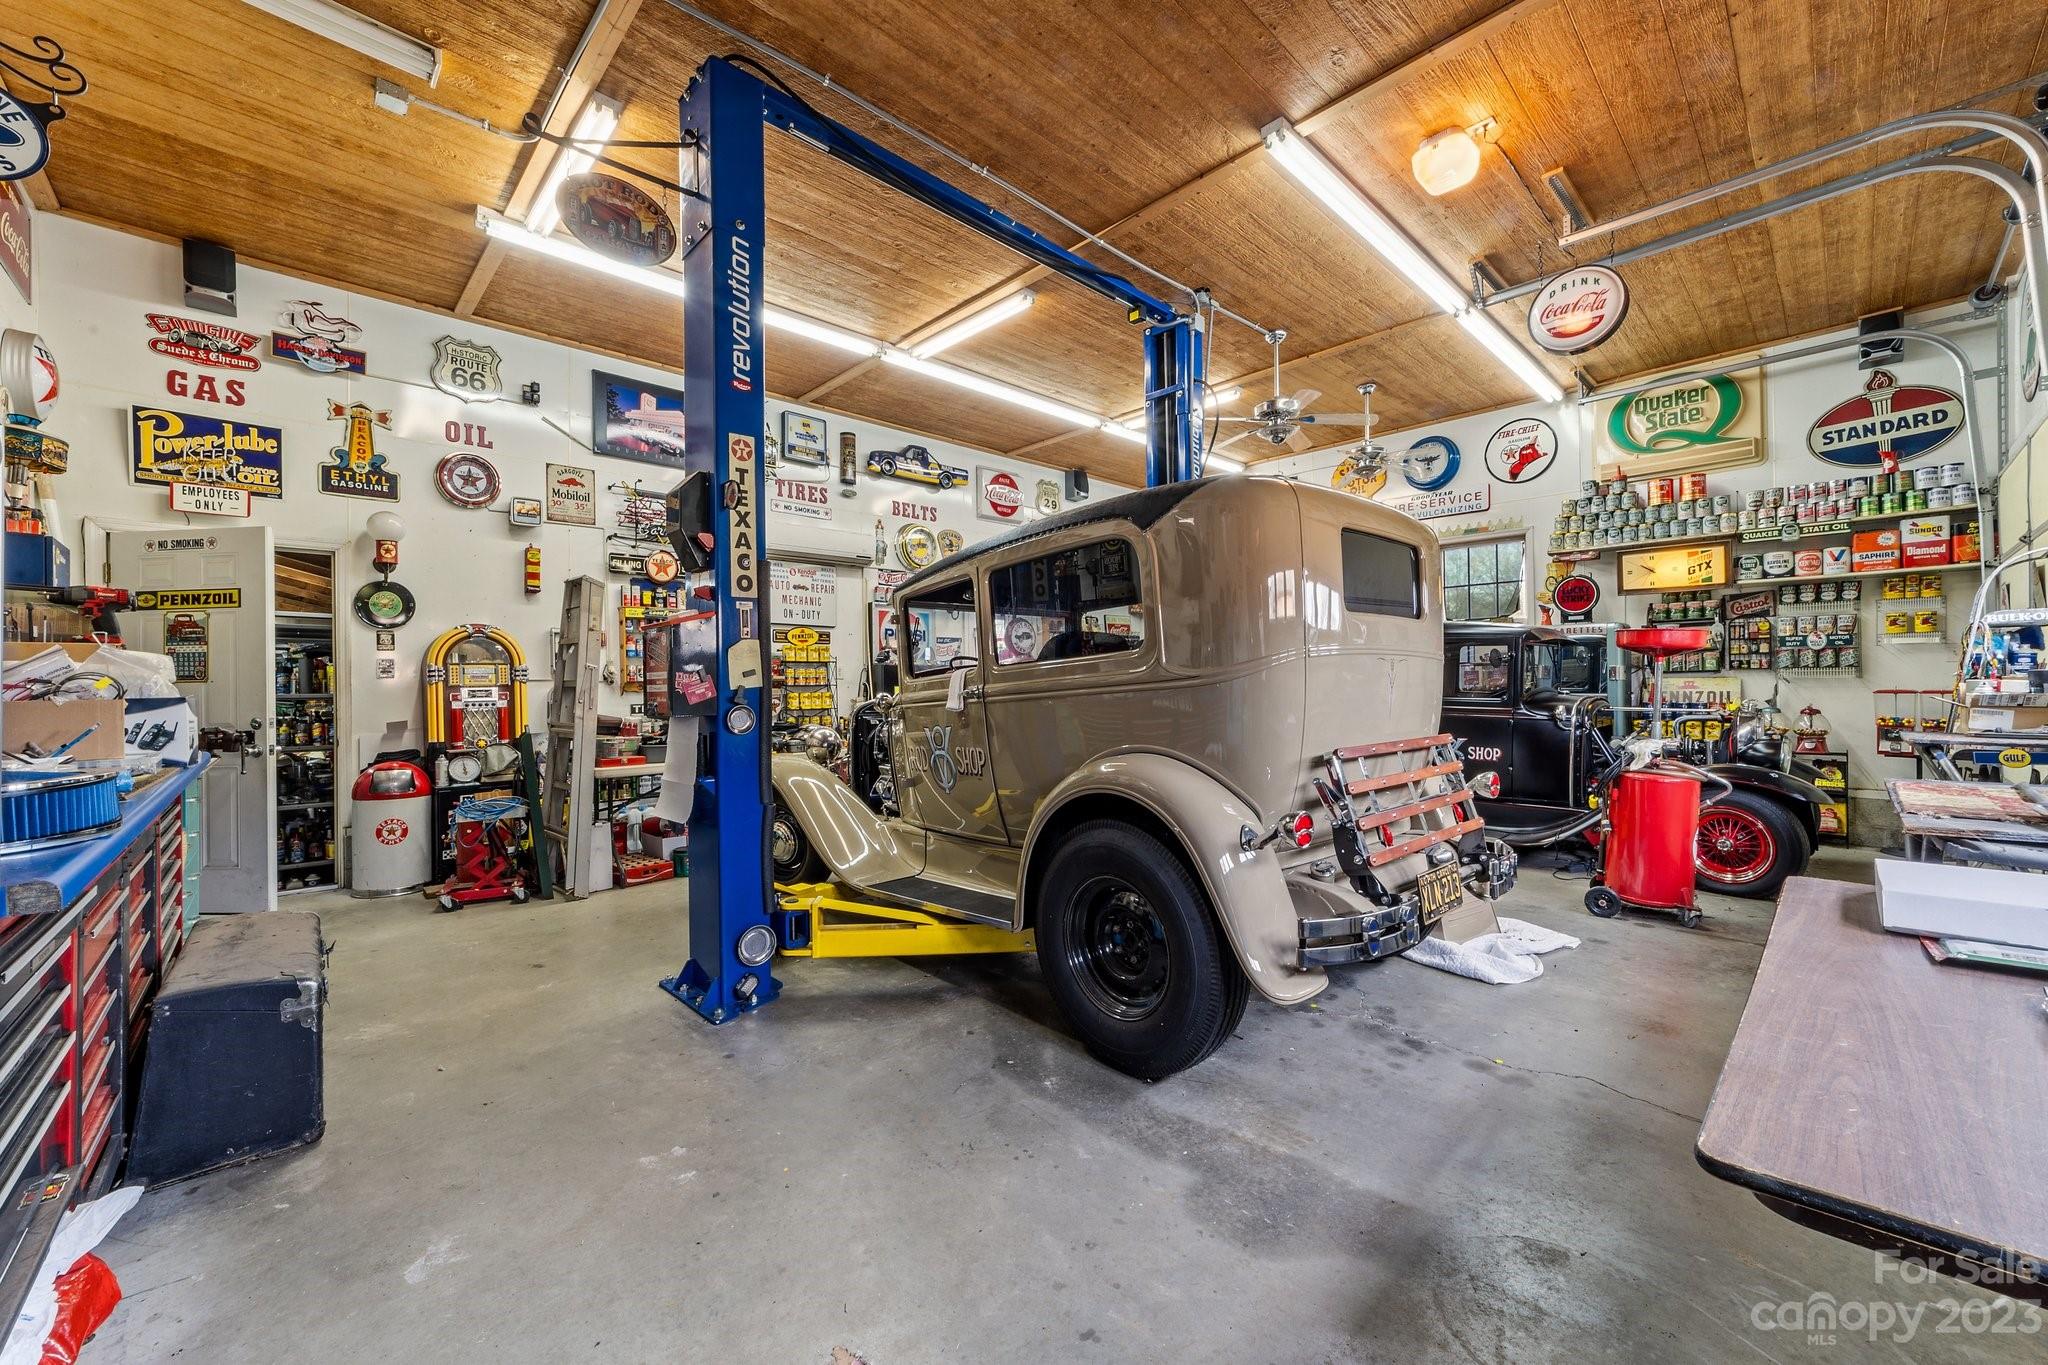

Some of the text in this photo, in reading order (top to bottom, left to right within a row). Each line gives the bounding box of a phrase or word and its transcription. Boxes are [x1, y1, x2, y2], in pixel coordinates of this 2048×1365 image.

[1549, 277, 1601, 299] DRINK
[728, 236, 751, 382] revolution
[1541, 288, 1611, 324] Coca-Cola
[156, 341, 196, 357] Suede
[198, 349, 207, 359] &
[209, 352, 256, 369] Chrome
[450, 357, 488, 373] ROUTE
[450, 367, 487, 392] 66
[166, 369, 246, 407] GAS
[1632, 385, 1711, 416] Quaker
[1645, 405, 1704, 433] State
[1822, 408, 1949, 446] STANDARD
[136, 410, 278, 470] Power-lube
[445, 420, 494, 450] OIL
[1498, 424, 1541, 440] FIRE-CHIEF
[356, 420, 367, 461] BEACON
[237, 472, 279, 486] OIL
[330, 469, 390, 486] ETHYL
[556, 468, 585, 479] GARGOYLE
[1345, 476, 1378, 487] OTOR
[182, 485, 241, 501] EMPLOYEES
[331, 479, 390, 492] GASOLINE
[775, 479, 829, 505] TIRES
[551, 487, 591, 503] Mobiloil
[1411, 490, 1453, 501] GOODYEAR
[195, 499, 224, 512] ONLY
[783, 504, 821, 516] NO SMOKING
[892, 500, 938, 523] BELTS
[1416, 502, 1483, 518] VULCANIZING
[734, 467, 753, 593] TEXACO
[1743, 523, 1850, 540] QUAKER STATE OIL
[1909, 525, 1944, 535] SUNOCO
[157, 538, 205, 549] NO SMOKING
[1907, 544, 1946, 556] Diamond
[612, 559, 642, 569] FILLING
[1859, 551, 1896, 561] SAPHIRE
[1687, 560, 1712, 576] GTX
[811, 583, 835, 595] REPAIR
[159, 592, 237, 606] PENNZOIL
[782, 594, 822, 607] MECHANIC
[1730, 595, 1770, 615] Castrol
[1986, 611, 2048, 623] BULK-O
[791, 633, 815, 641] PENNZOIL
[955, 746, 986, 776] SHOP
[1467, 746, 1501, 761] SHOP
[2002, 753, 2027, 764] GULF
[377, 819, 408, 830] TEXACO
[378, 836, 405, 846] ETHYL
